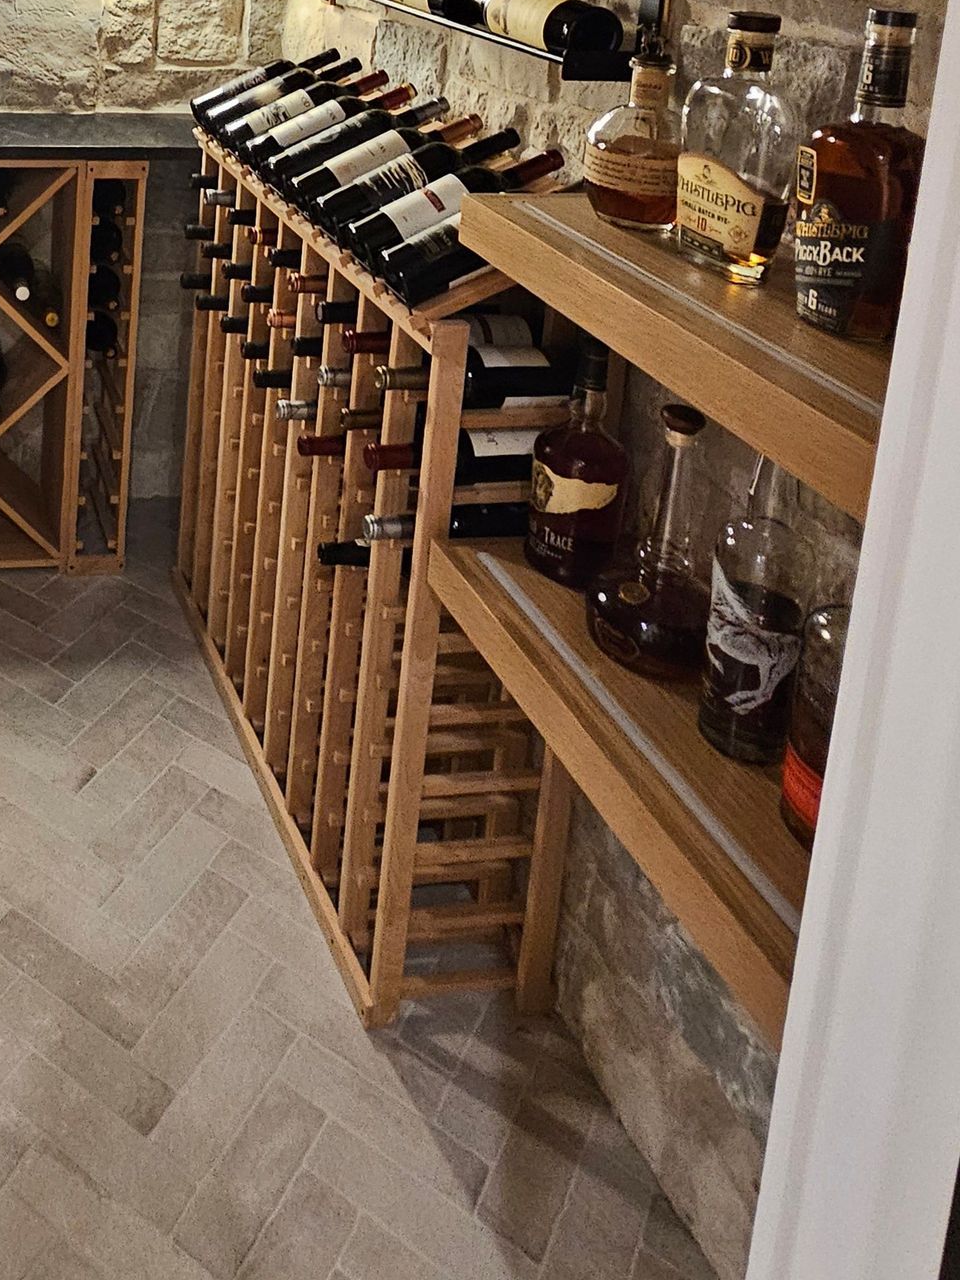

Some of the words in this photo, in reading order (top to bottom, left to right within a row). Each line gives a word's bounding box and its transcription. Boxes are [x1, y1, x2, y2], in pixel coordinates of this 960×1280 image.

[863, 63, 874, 84] 6
[696, 215, 707, 232] 10
[795, 221, 869, 240] WHISTLEPIG
[807, 288, 818, 310] 6
[544, 526, 574, 552] TRACE
